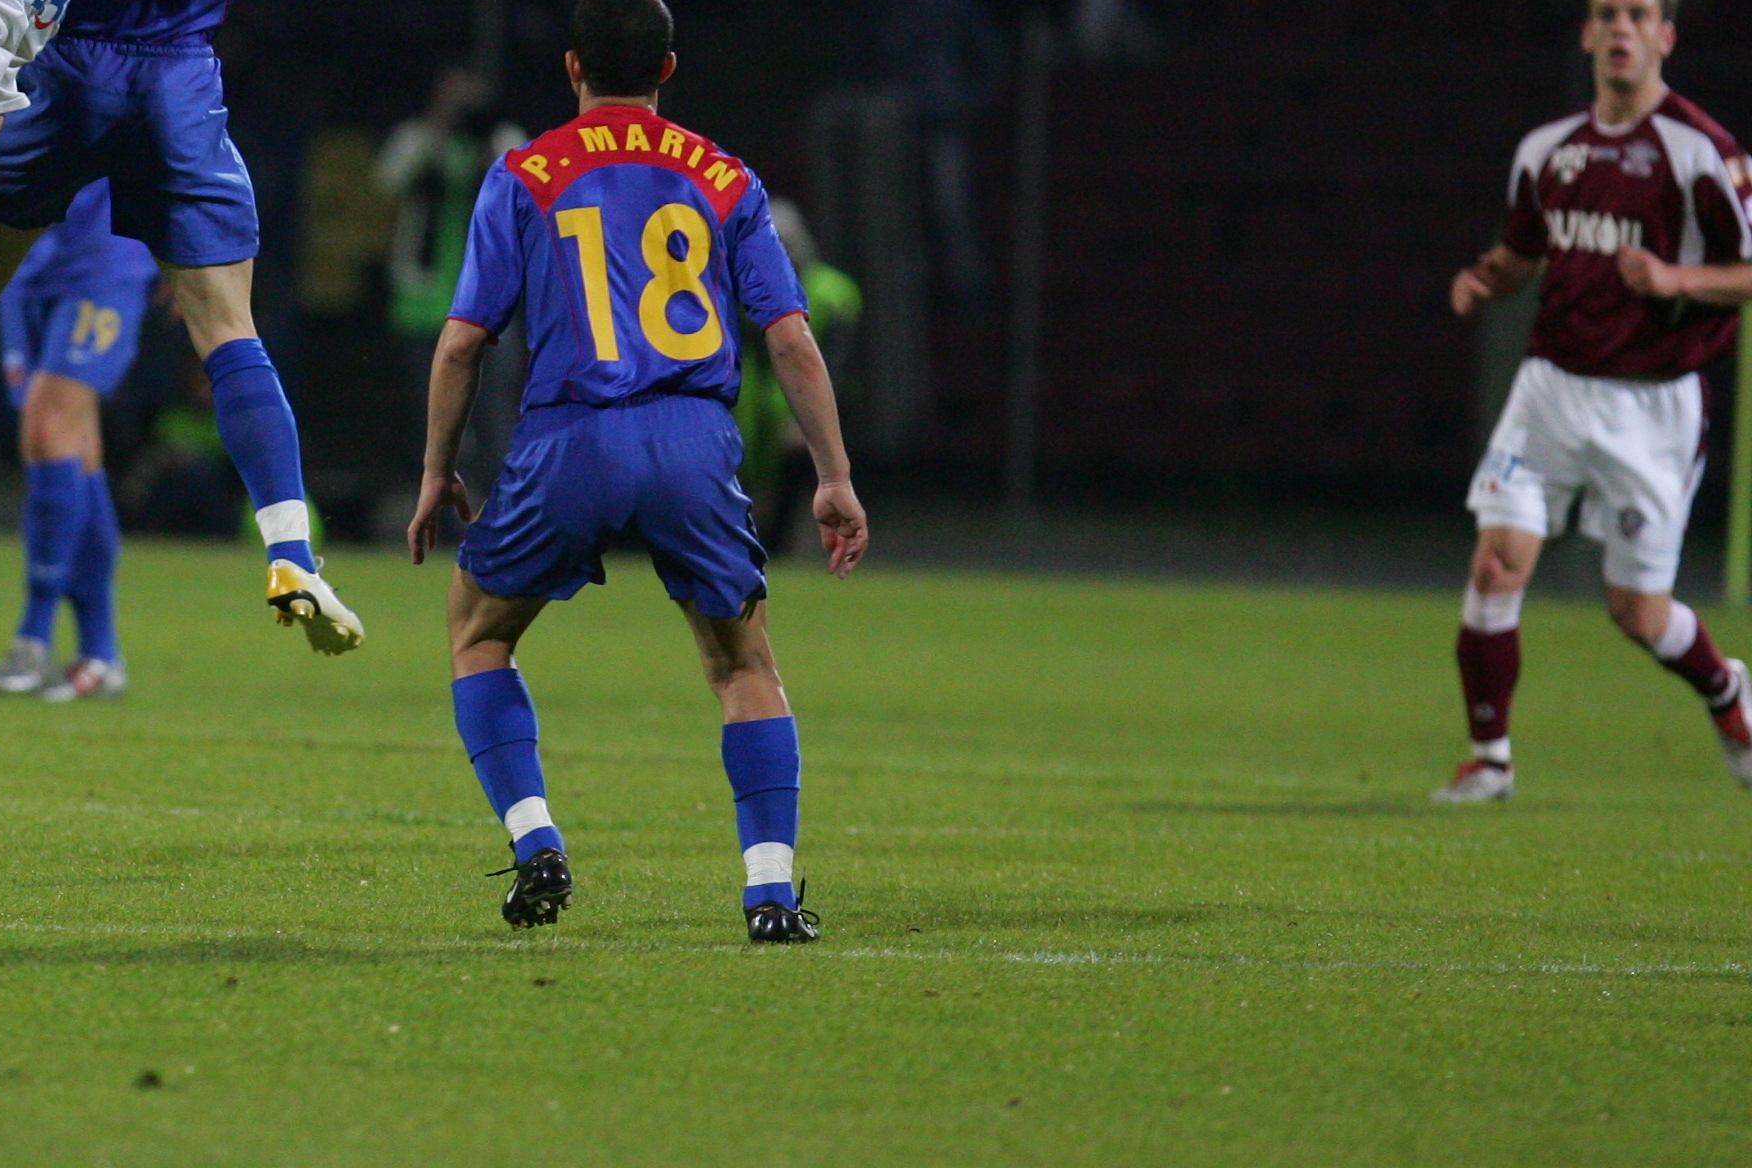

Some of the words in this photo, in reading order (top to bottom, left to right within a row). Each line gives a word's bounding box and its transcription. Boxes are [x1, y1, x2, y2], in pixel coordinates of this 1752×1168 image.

[520, 153, 571, 184] P.
[577, 122, 741, 193] MARIN
[554, 202, 724, 361] 18
